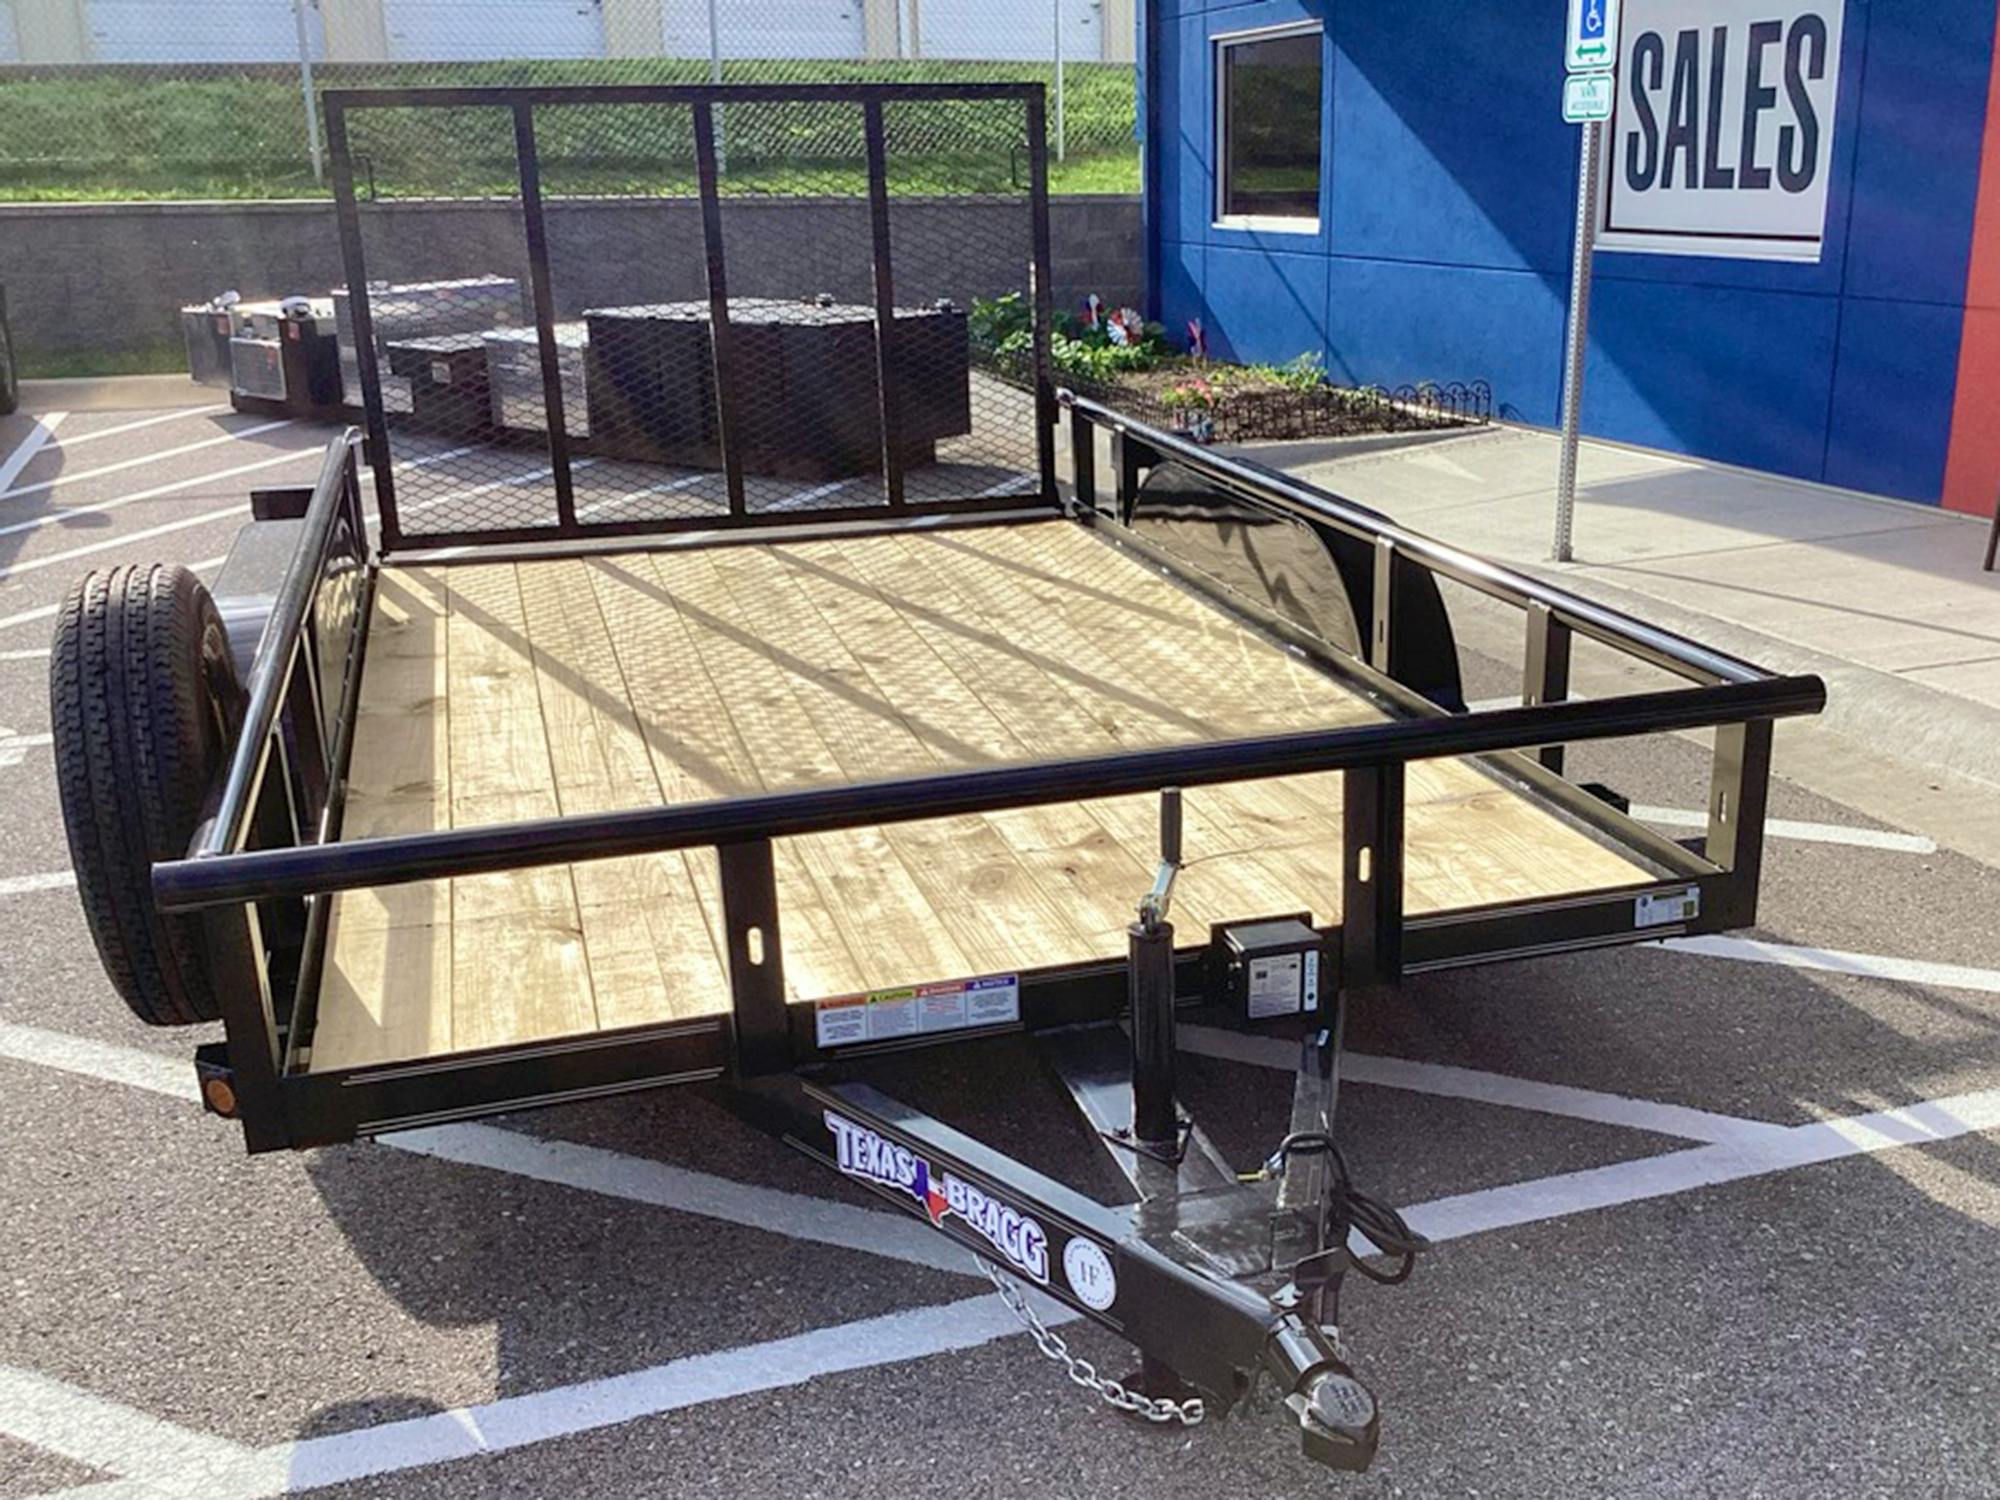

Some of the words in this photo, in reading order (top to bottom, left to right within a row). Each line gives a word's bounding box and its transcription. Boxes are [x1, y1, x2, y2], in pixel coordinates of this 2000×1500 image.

[1626, 13, 1827, 193] SALES
[823, 1109, 917, 1188] TEXAS
[943, 1172, 1049, 1284] BRAGG
